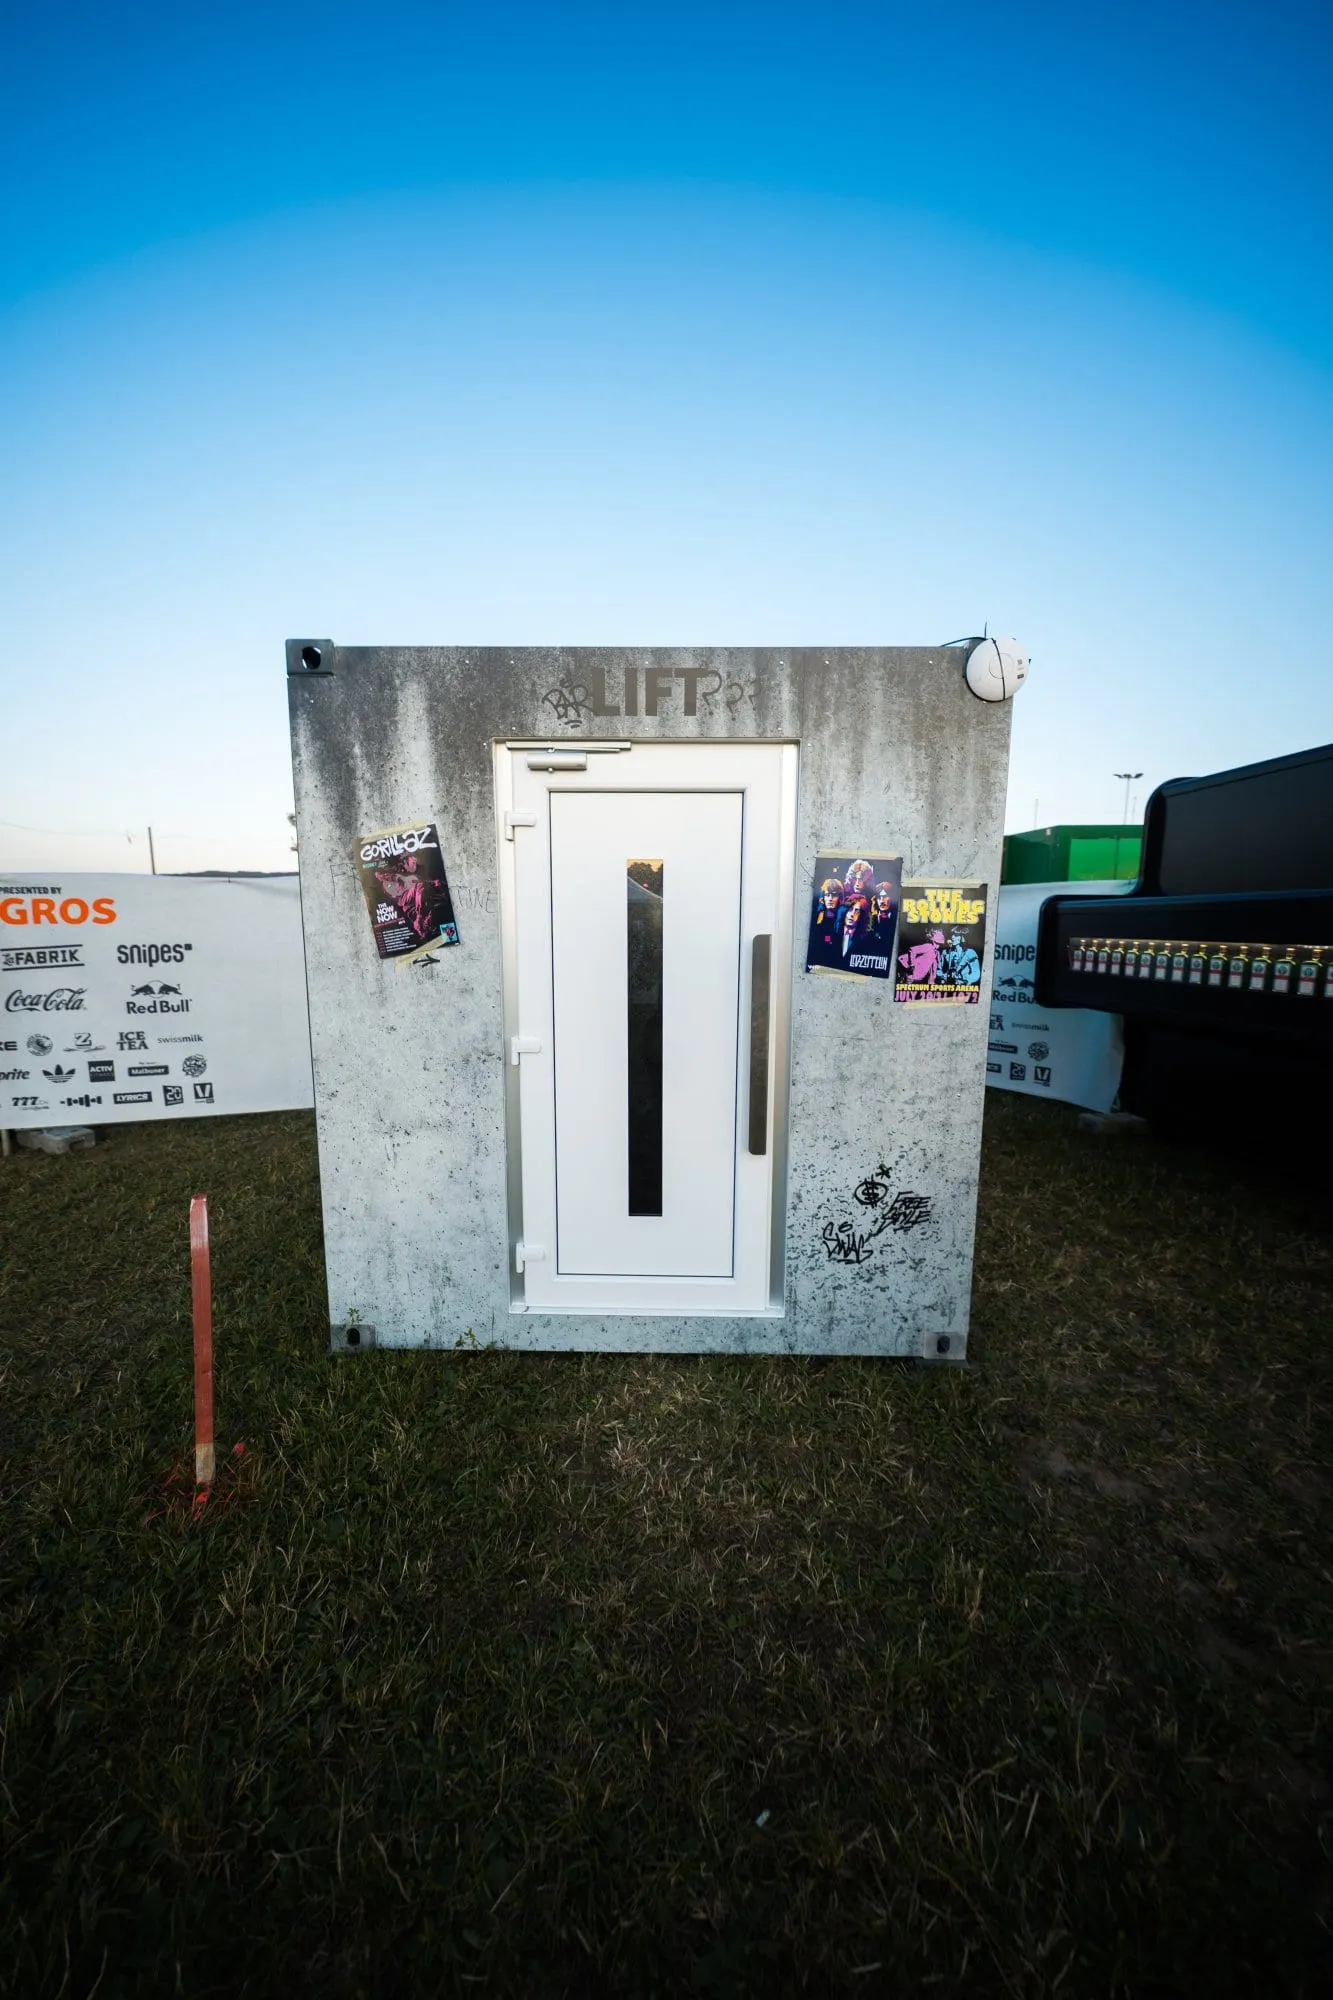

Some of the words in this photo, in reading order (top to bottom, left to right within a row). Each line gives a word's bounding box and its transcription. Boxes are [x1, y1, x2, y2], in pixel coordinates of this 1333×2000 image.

[593, 668, 708, 716] LIFT
[924, 888, 963, 901] THE
[0, 898, 117, 924] GROS
[376, 905, 394, 916] NOW
[902, 898, 985, 914] ROLLING
[377, 911, 398, 924] NOW
[907, 911, 980, 924] STONES
[15, 949, 80, 965] FABRIK
[5, 988, 88, 1012] Coca-Cola
[895, 991, 917, 1001] JULY
[953, 991, 978, 1003] 1972
[992, 990, 1016, 1002] Red
[126, 1001, 158, 1014] Red
[159, 999, 190, 1013] Bull
[118, 1031, 146, 1041] ICE
[157, 1034, 204, 1043] swissmilk
[116, 1040, 149, 1051] TEA
[116, 1093, 149, 1102] LYRICS
[166, 1087, 182, 1100] 20
[12, 1096, 39, 1106] 777
